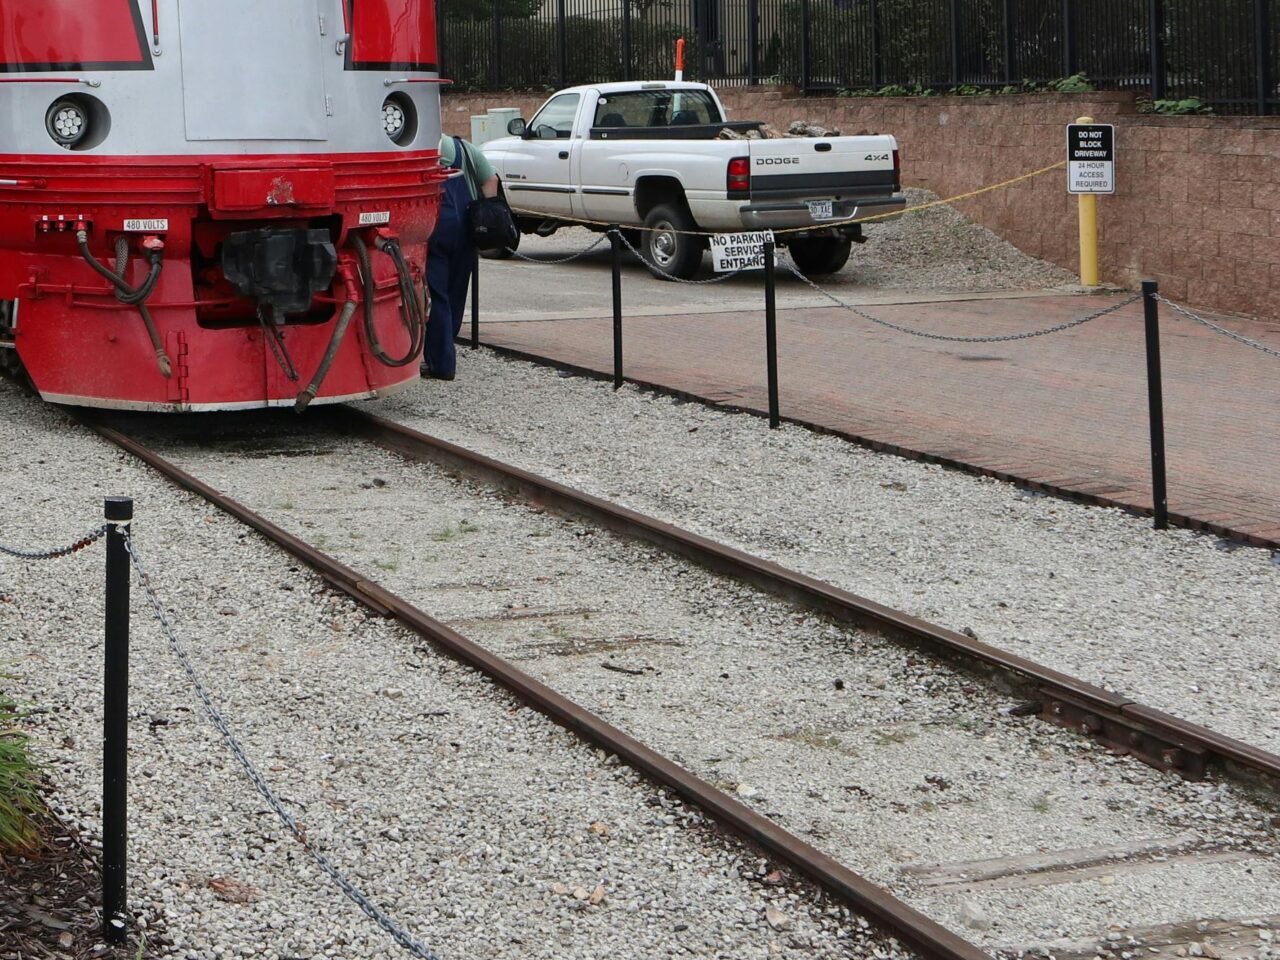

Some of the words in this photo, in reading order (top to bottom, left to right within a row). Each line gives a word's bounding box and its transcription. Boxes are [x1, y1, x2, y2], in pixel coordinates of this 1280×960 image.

[1074, 150, 1107, 158] DRIVEWAY
[756, 157, 800, 166] DODGE
[126, 220, 141, 230] 480
[143, 220, 165, 230] VOLTS
[712, 236, 727, 246] NO
[730, 232, 772, 245] PARKING
[720, 255, 766, 269] ENTRANC
